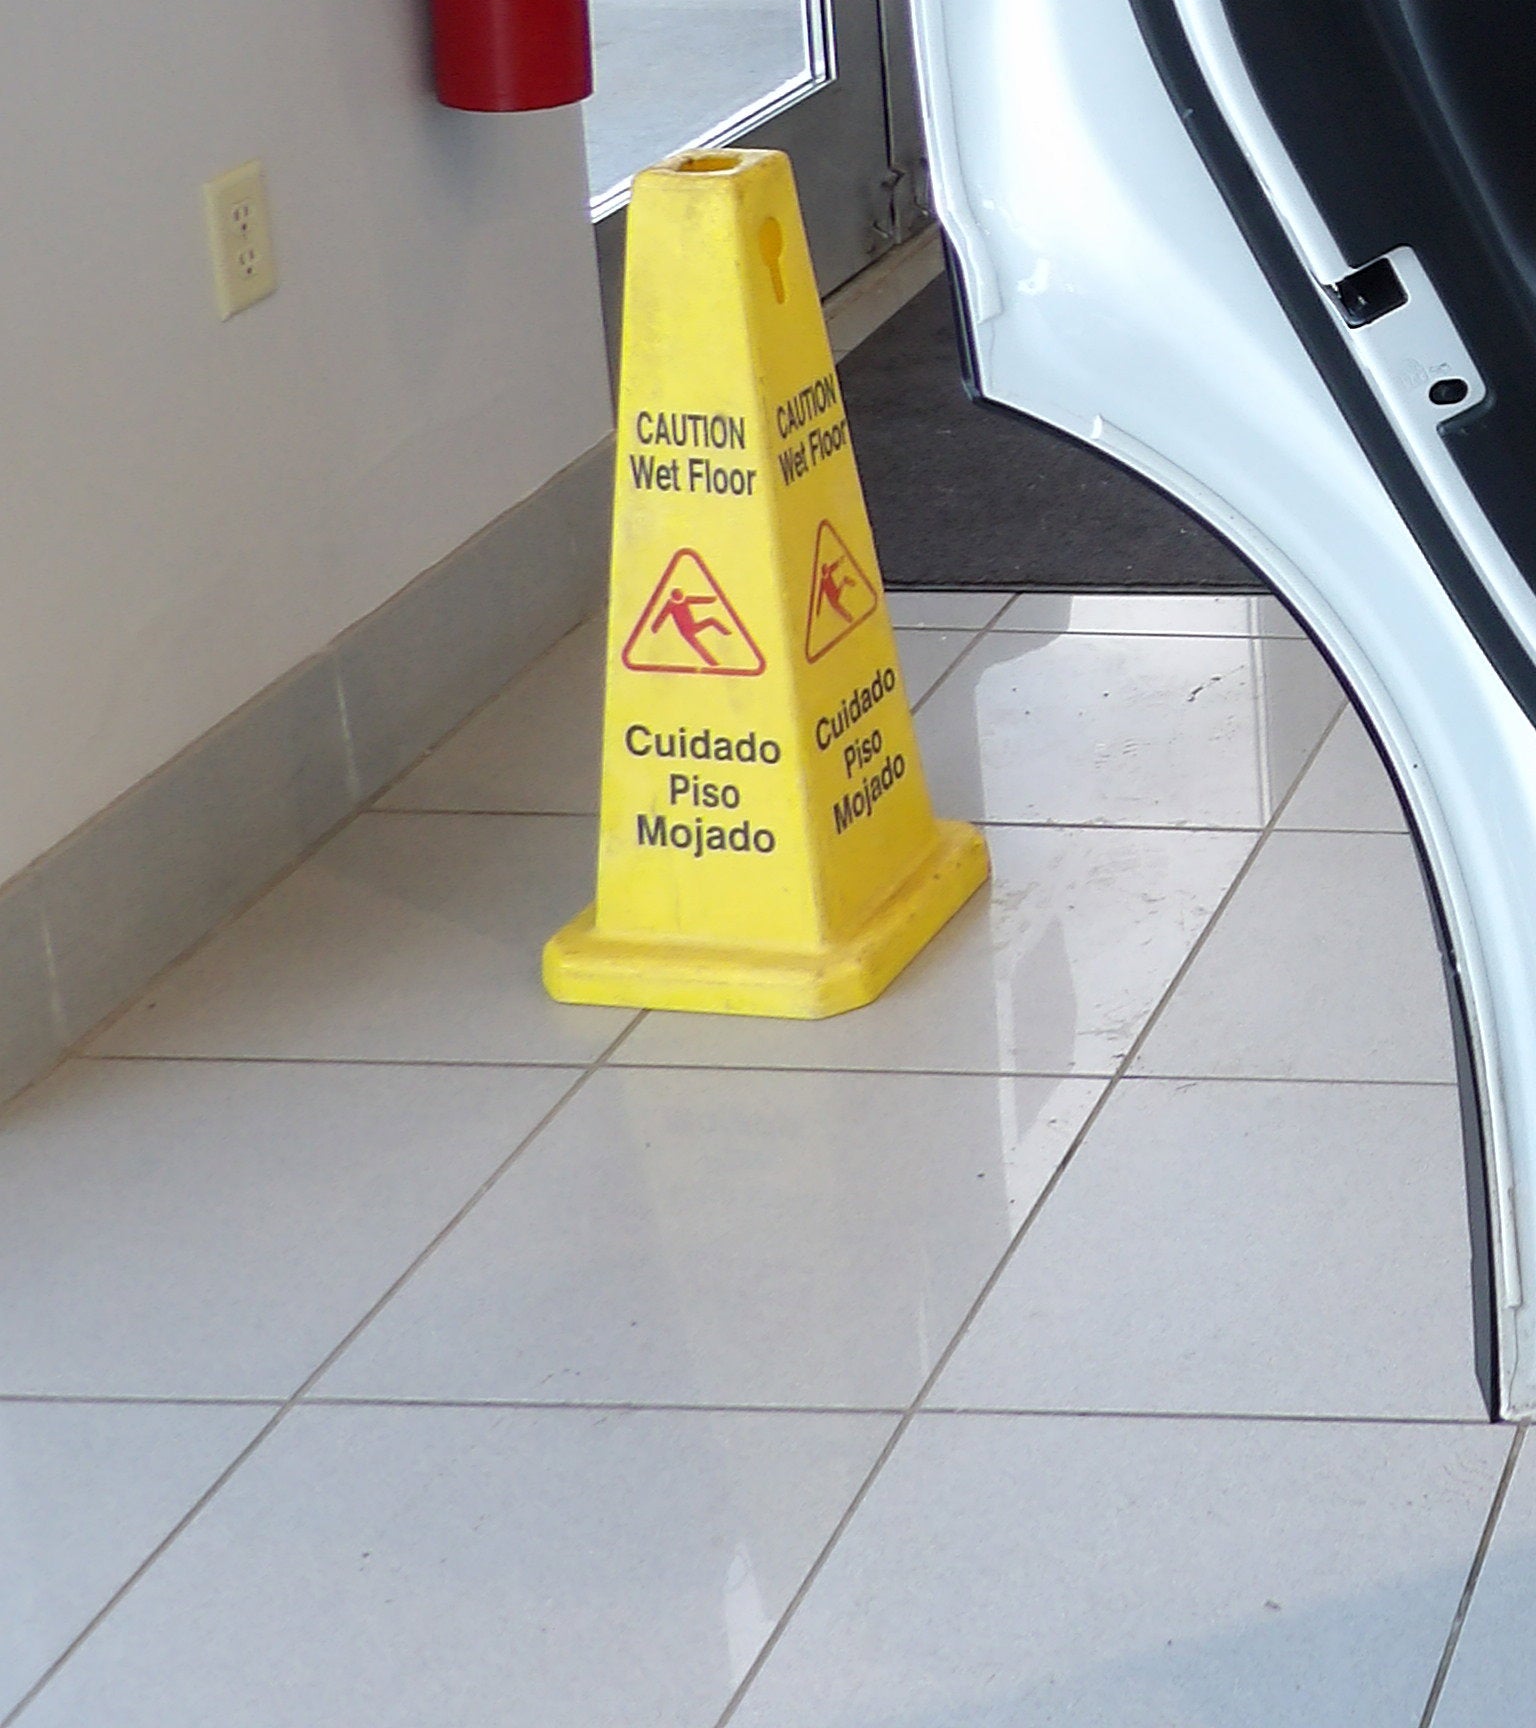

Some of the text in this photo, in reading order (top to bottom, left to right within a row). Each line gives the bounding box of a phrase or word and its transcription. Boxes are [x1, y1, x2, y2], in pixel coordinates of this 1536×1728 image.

[776, 373, 837, 439] CAUTION
[637, 410, 745, 450] CAUTION
[778, 419, 847, 486] Wet Floor
[629, 454, 757, 496] Wet Floor
[815, 667, 895, 751] Cuidado
[625, 724, 781, 765] Cuidado
[844, 729, 882, 779] Piso
[670, 773, 740, 809] Piso
[833, 753, 905, 835] Mojado
[637, 813, 776, 858] Mojado
